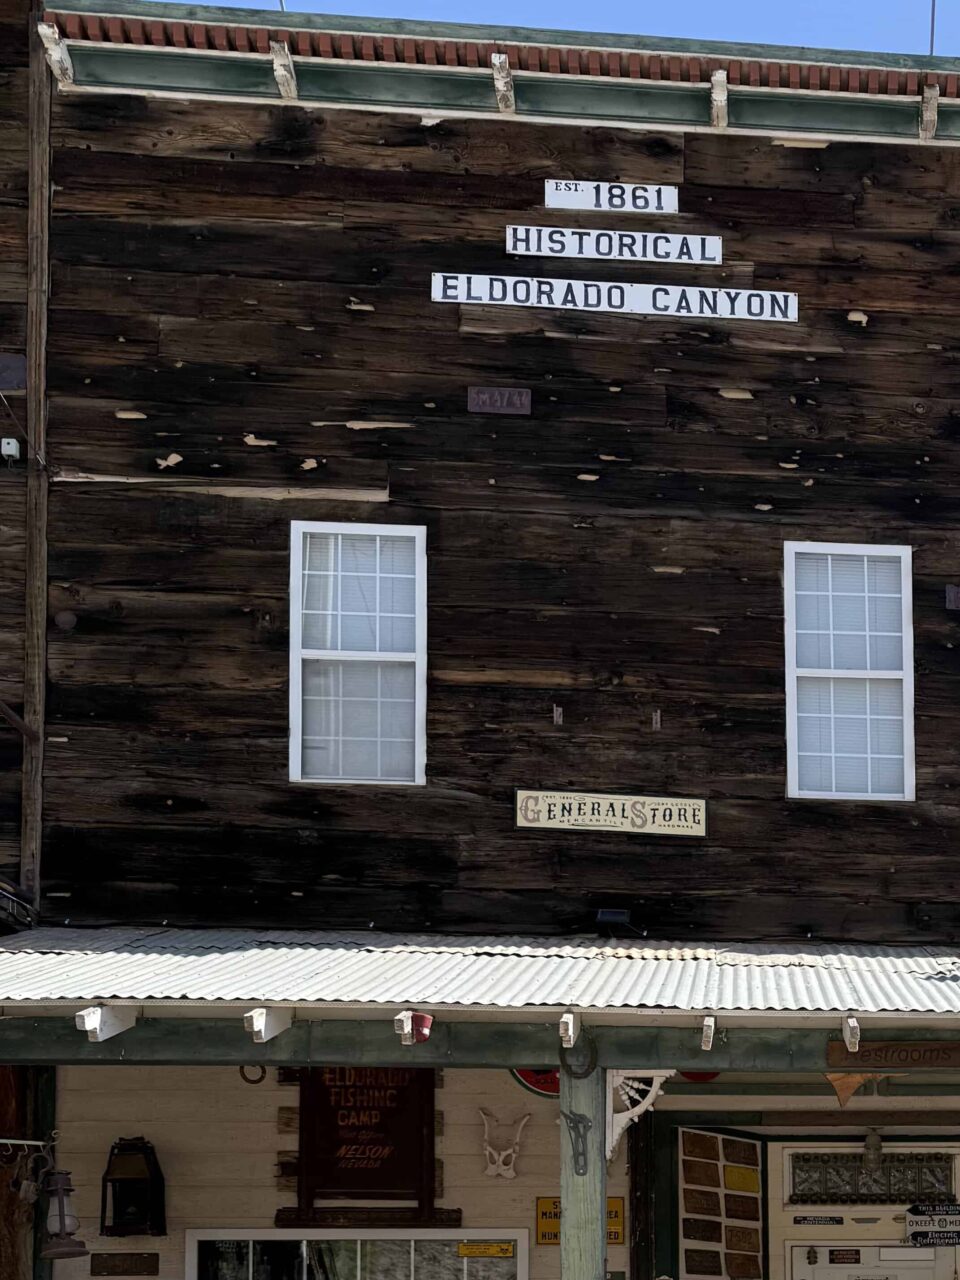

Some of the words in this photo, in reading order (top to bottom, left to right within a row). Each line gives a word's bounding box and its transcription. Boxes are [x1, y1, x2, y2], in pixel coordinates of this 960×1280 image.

[555, 181, 584, 193] EST.
[593, 184, 664, 211] 1861
[511, 227, 717, 262] HISTORICAL
[441, 275, 625, 309] ELDORADO
[652, 287, 790, 319] CANYON
[519, 796, 629, 823] GENERAL
[630, 800, 701, 829] STORE
[845, 1048, 951, 1063] Restrooms
[338, 1110, 380, 1126] CAMP
[336, 1145, 395, 1158] NELSON
